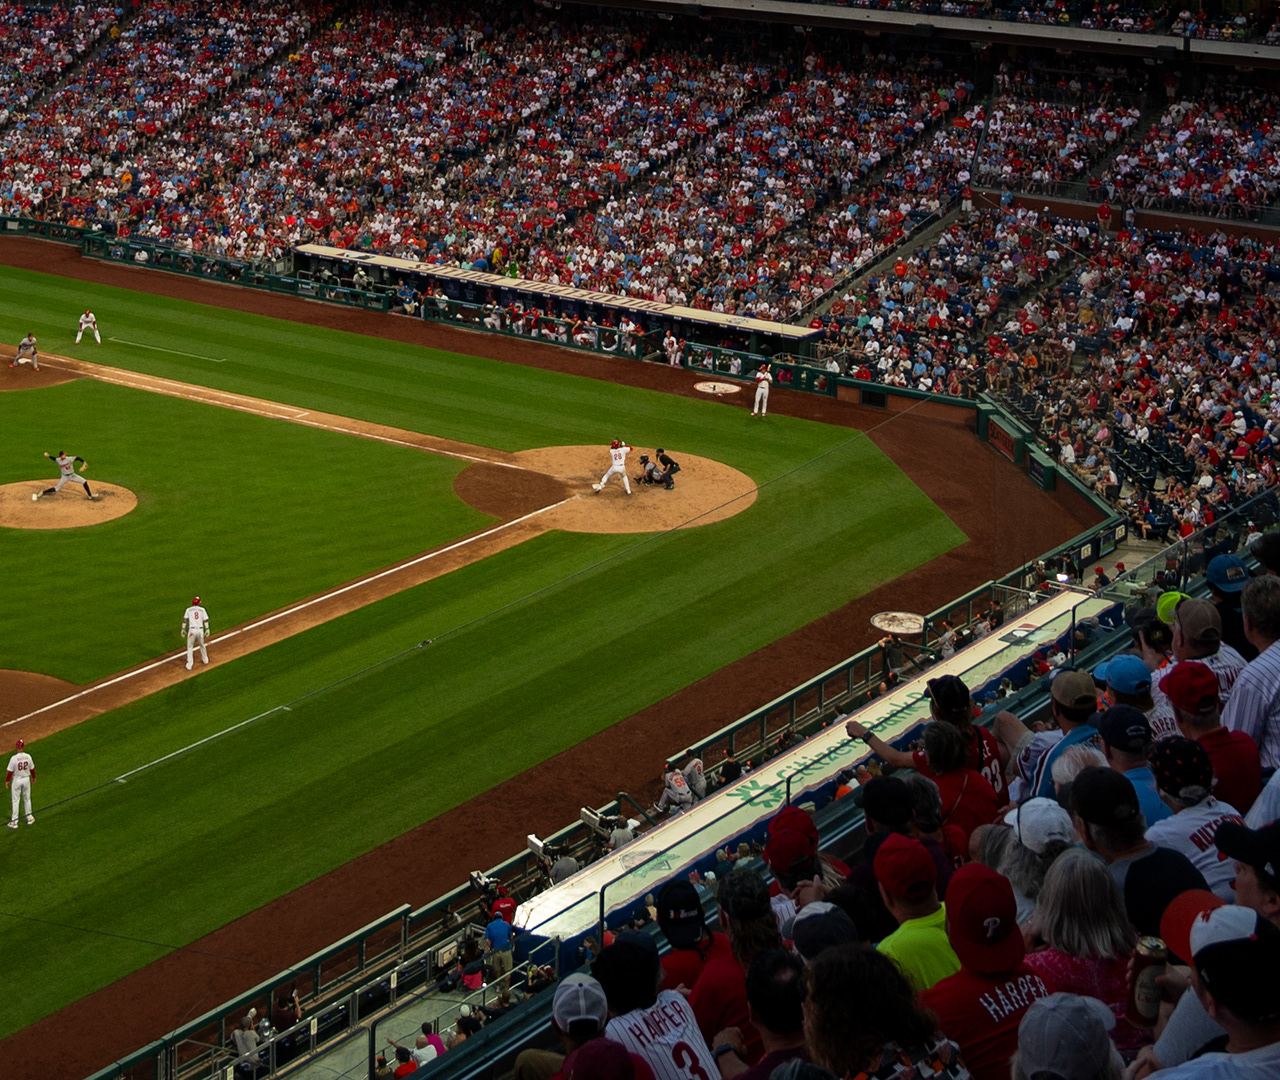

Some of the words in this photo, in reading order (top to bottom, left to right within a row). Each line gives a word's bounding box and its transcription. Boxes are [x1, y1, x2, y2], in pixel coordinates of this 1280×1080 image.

[194, 611, 200, 620] 8
[16, 761, 29, 772] 62
[983, 916, 1001, 939] P
[978, 973, 1050, 1023] HARPER
[628, 1000, 688, 1049] HARPER
[671, 1041, 711, 1080] 3
